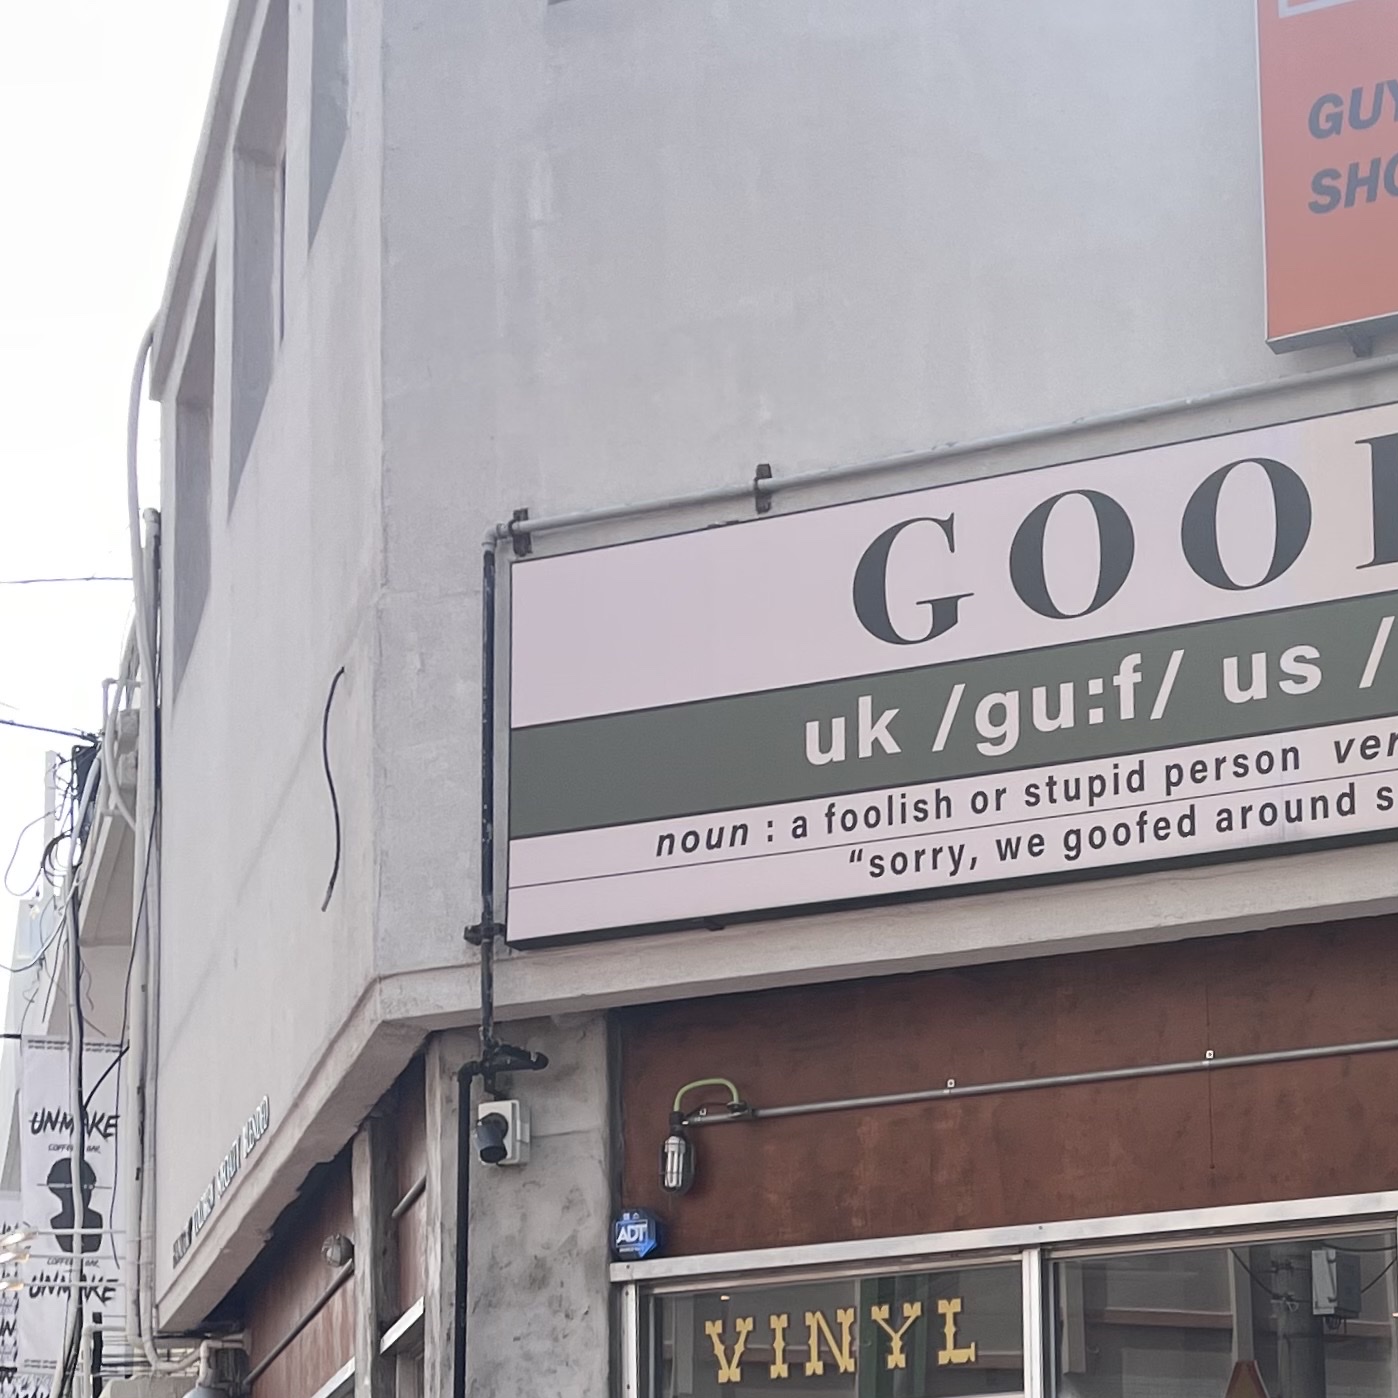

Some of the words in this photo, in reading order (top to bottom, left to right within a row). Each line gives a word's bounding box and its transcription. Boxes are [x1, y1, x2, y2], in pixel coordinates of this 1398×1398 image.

[805, 695, 900, 765] uk
[932, 650, 1186, 757] /gu:f/
[1222, 643, 1323, 704] us
[656, 819, 750, 858] noun
[791, 813, 809, 840] a
[825, 787, 954, 836] foolish
[970, 784, 1009, 816] or
[1023, 760, 1147, 810] stupid
[1164, 741, 1302, 797] person
[995, 831, 1046, 863] we
[1062, 797, 1198, 860] goofed
[1215, 779, 1357, 833] around
[616, 1223, 648, 1244] ADT
[705, 1298, 976, 1384] VINYL
